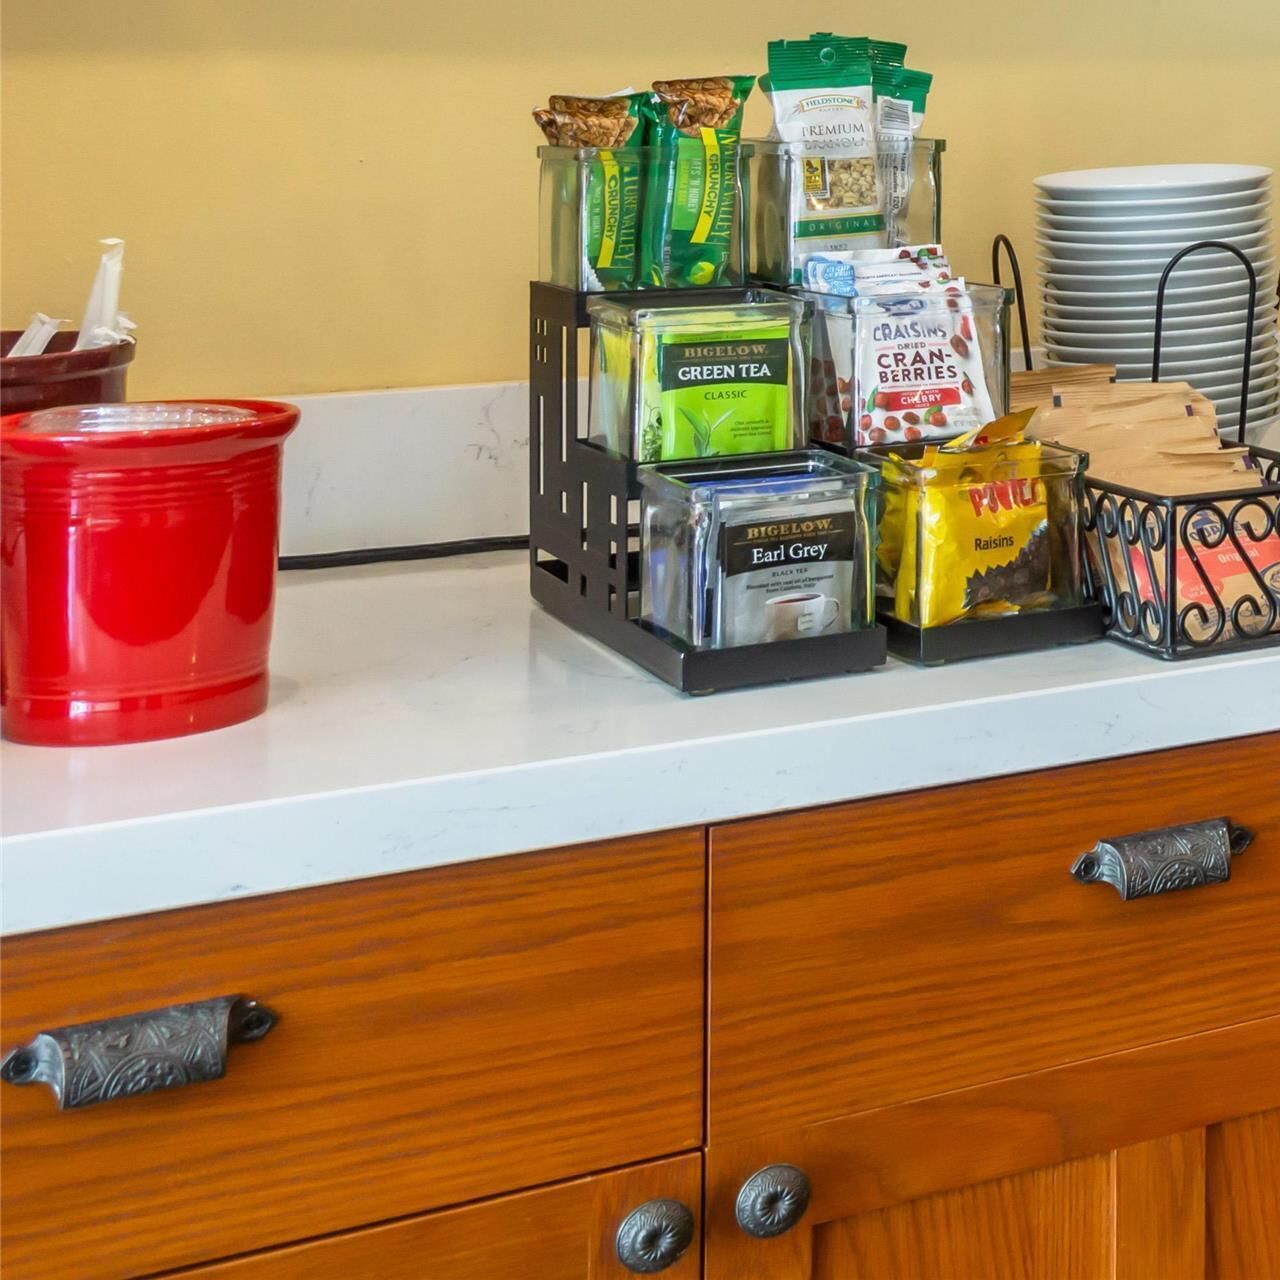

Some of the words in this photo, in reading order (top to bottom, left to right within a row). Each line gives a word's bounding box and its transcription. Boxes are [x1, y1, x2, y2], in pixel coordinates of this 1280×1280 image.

[805, 96, 854, 108] FIELDSTONE
[802, 123, 865, 138] PREMIUM
[704, 153, 720, 218] CRUNCHY
[605, 175, 619, 241] CRUNCHY
[809, 219, 877, 233] ORIGINAL
[614, 213, 635, 261] VALLEY
[873, 322, 947, 341] CRAISINS
[684, 344, 768, 358] BIGELOW
[897, 341, 926, 350] DRIED
[877, 348, 952, 369] CRAN-
[678, 365, 735, 381] GREEN
[738, 363, 771, 377] TEA
[879, 365, 957, 384] BERRIES
[704, 390, 747, 401] CLASSIC
[901, 394, 942, 405] CHERRY
[746, 518, 832, 540] BIGELOW
[974, 535, 1015, 551] Raisins
[751, 544, 785, 564] Earl
[789, 543, 828, 560] Grey
